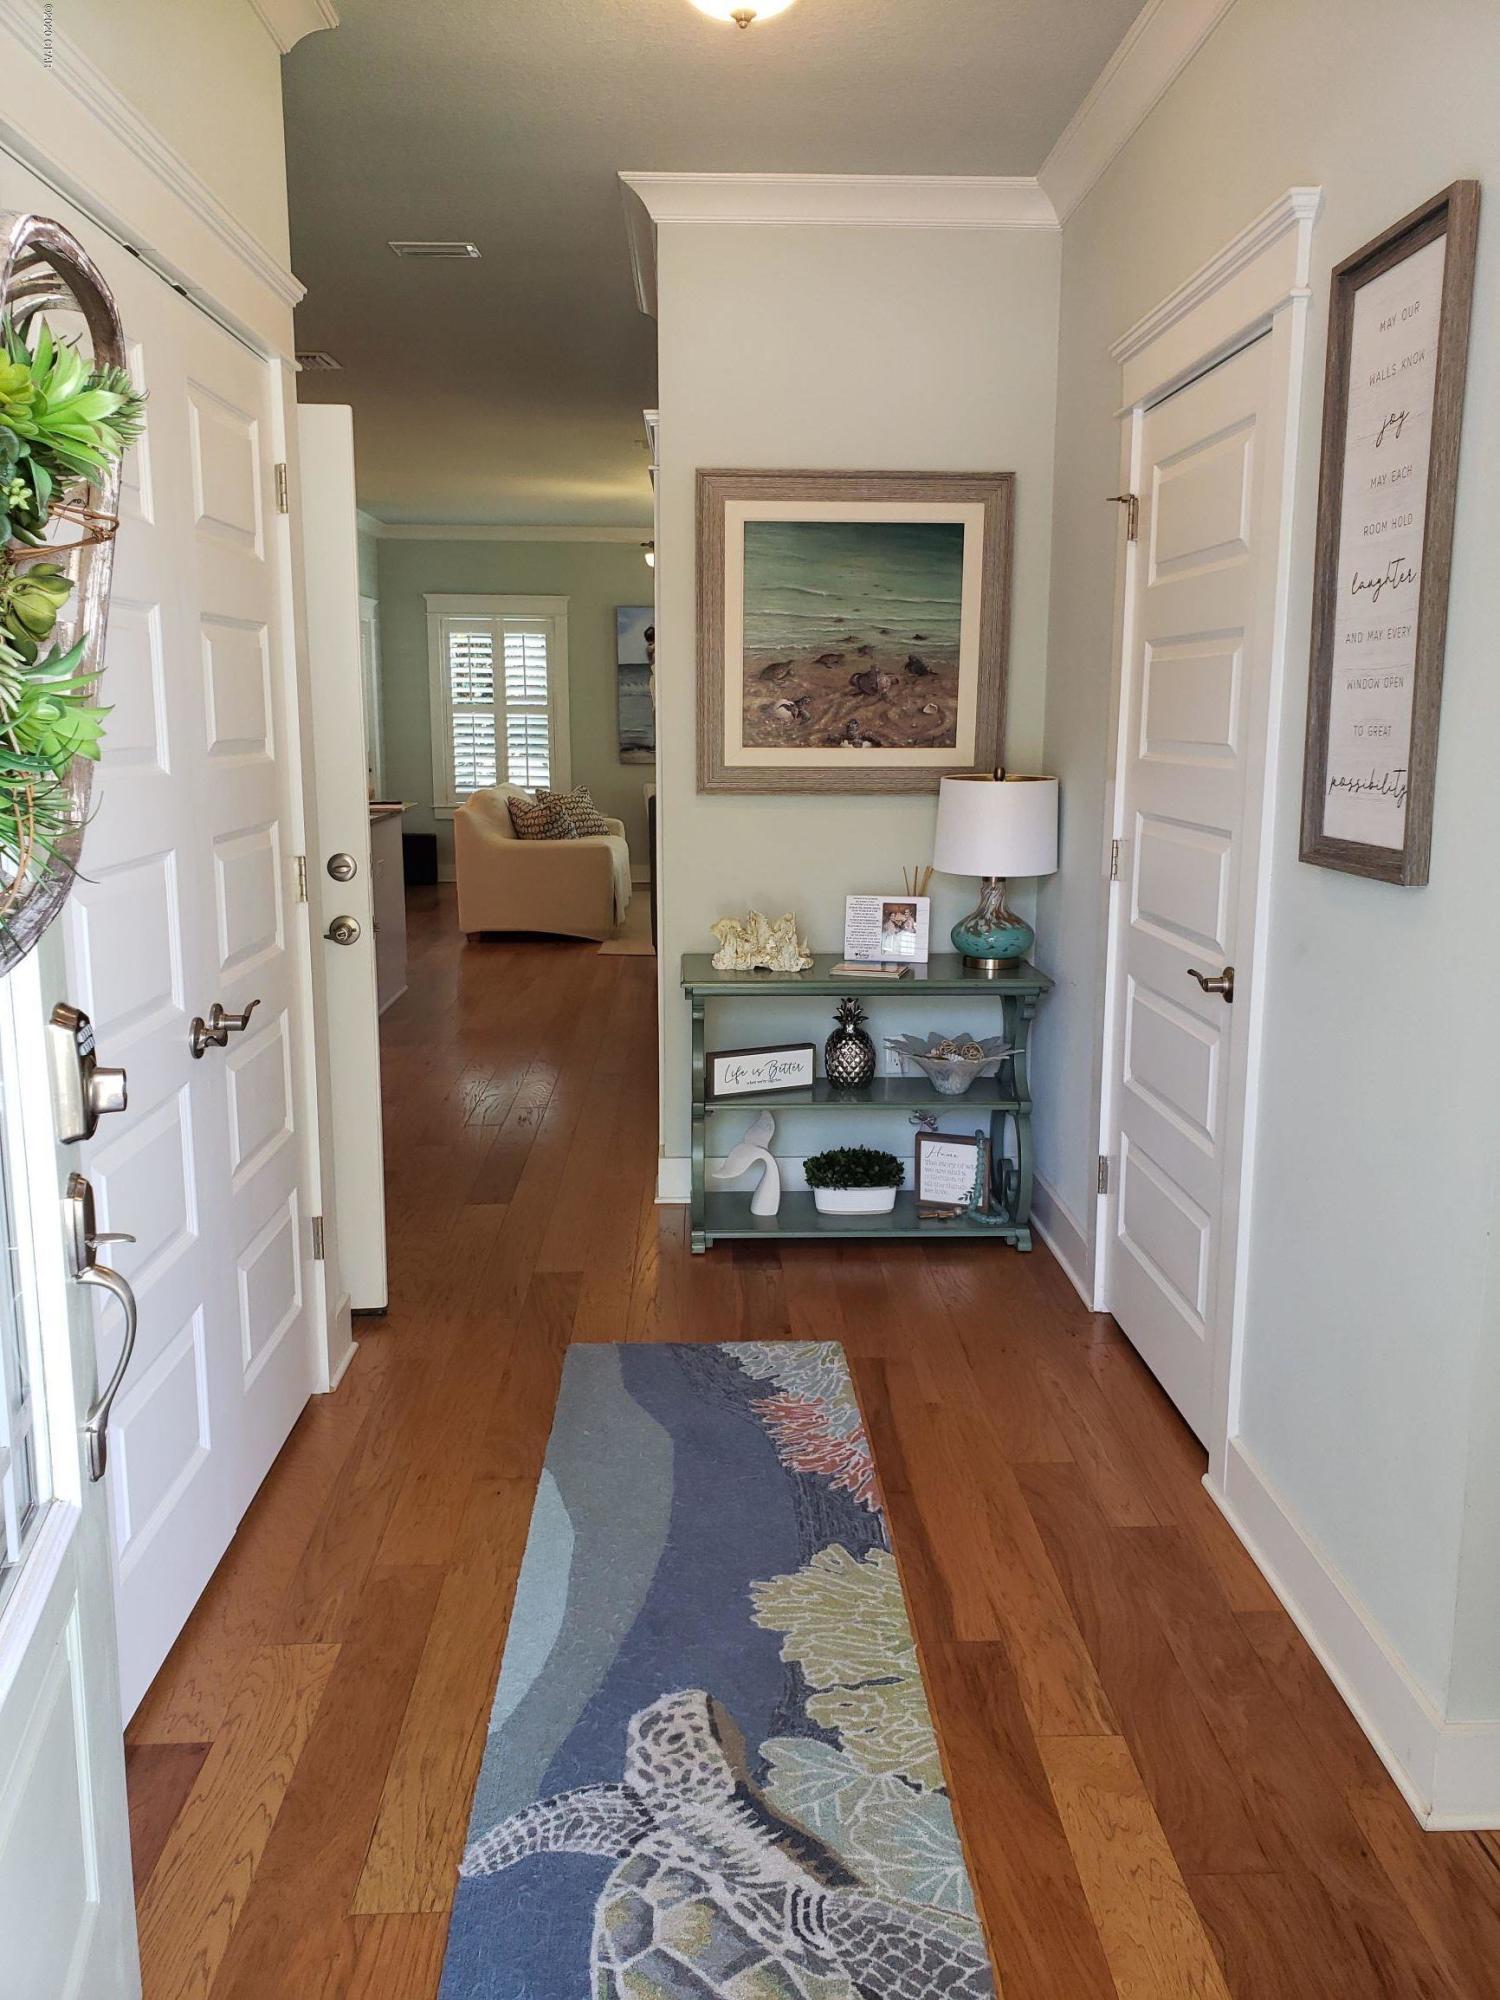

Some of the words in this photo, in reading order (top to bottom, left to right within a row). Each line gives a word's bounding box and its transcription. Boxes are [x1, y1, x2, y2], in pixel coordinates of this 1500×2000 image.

[1379, 313, 1398, 332] MAY
[1401, 301, 1420, 321] OUR
[1368, 363, 1397, 387] WALLS
[1401, 350, 1425, 369] KNOW
[1375, 410, 1410, 448] joy
[1370, 473, 1387, 489] MAY
[1391, 464, 1413, 482] EACH
[1363, 520, 1388, 536] ROOM
[1391, 513, 1413, 529] HOLD
[1351, 557, 1417, 603] laughter
[1345, 631, 1363, 645] AND
[1367, 628, 1384, 642] MAY
[1387, 625, 1412, 640] EVERY
[1346, 678, 1380, 690] WINDOW
[1383, 676, 1405, 689] OPEN
[1353, 725, 1364, 737] TO
[1367, 725, 1392, 737] GREAT
[725, 1063, 748, 1085] Life
[751, 1067, 766, 1078] is
[764, 1060, 805, 1080] Better
